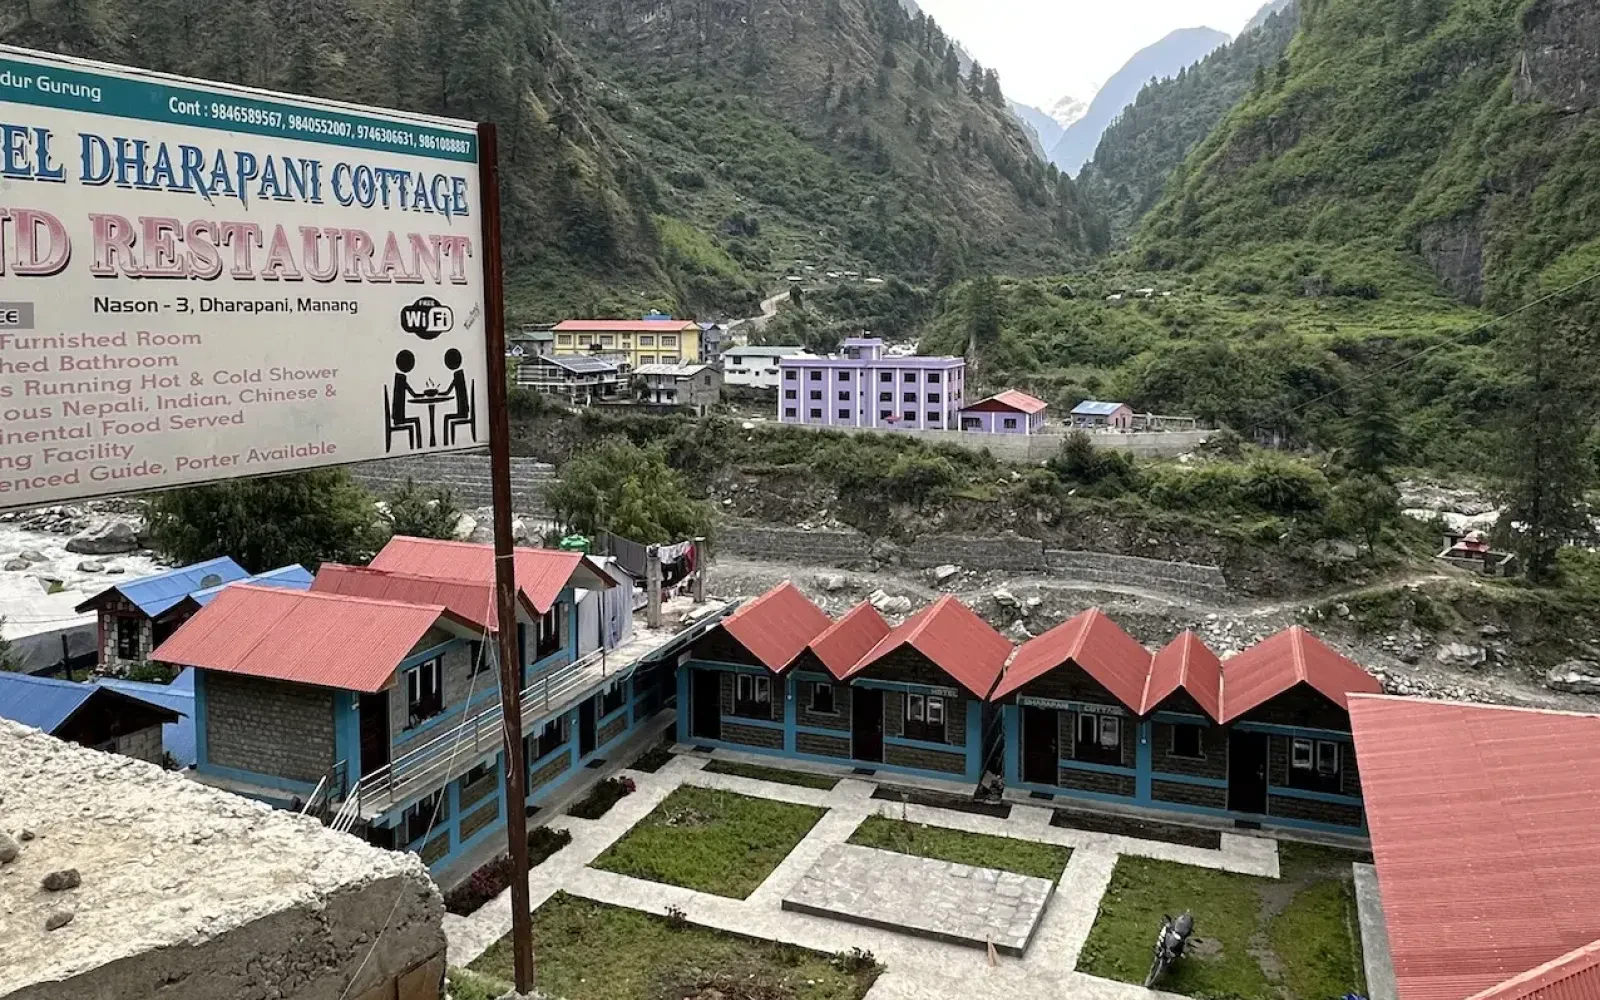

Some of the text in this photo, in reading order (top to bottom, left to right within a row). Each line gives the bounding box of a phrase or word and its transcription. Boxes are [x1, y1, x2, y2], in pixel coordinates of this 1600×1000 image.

[36, 75, 101, 103] Gurung
[169, 96, 201, 116] Cont
[211, 102, 286, 131] 9846589567,
[288, 114, 355, 139] 9840552007,
[357, 125, 417, 149] 9746306631,
[78, 132, 324, 212] DHARAPANI
[330, 162, 470, 226] COTTAGE
[0, 207, 473, 286] D RESTAURANT
[93, 297, 159, 313] Nason
[176, 298, 194, 314] 3,
[200, 297, 293, 316] Dharapani,
[297, 298, 358, 314] Manang
[0, 330, 202, 350] Furnished Room
[59, 354, 179, 372] Bathroom
[24, 377, 131, 397] Running
[141, 373, 180, 390] Hot
[190, 371, 204, 387] &
[213, 369, 262, 385] Cold
[269, 366, 339, 382] Shower
[4, 384, 337, 421] ous Nepali, Indian, Chinese &
[102, 417, 160, 436] Food
[169, 410, 245, 430] Served
[0, 440, 337, 493] enced Guide, Porter Available
[42, 443, 134, 465] Facility
